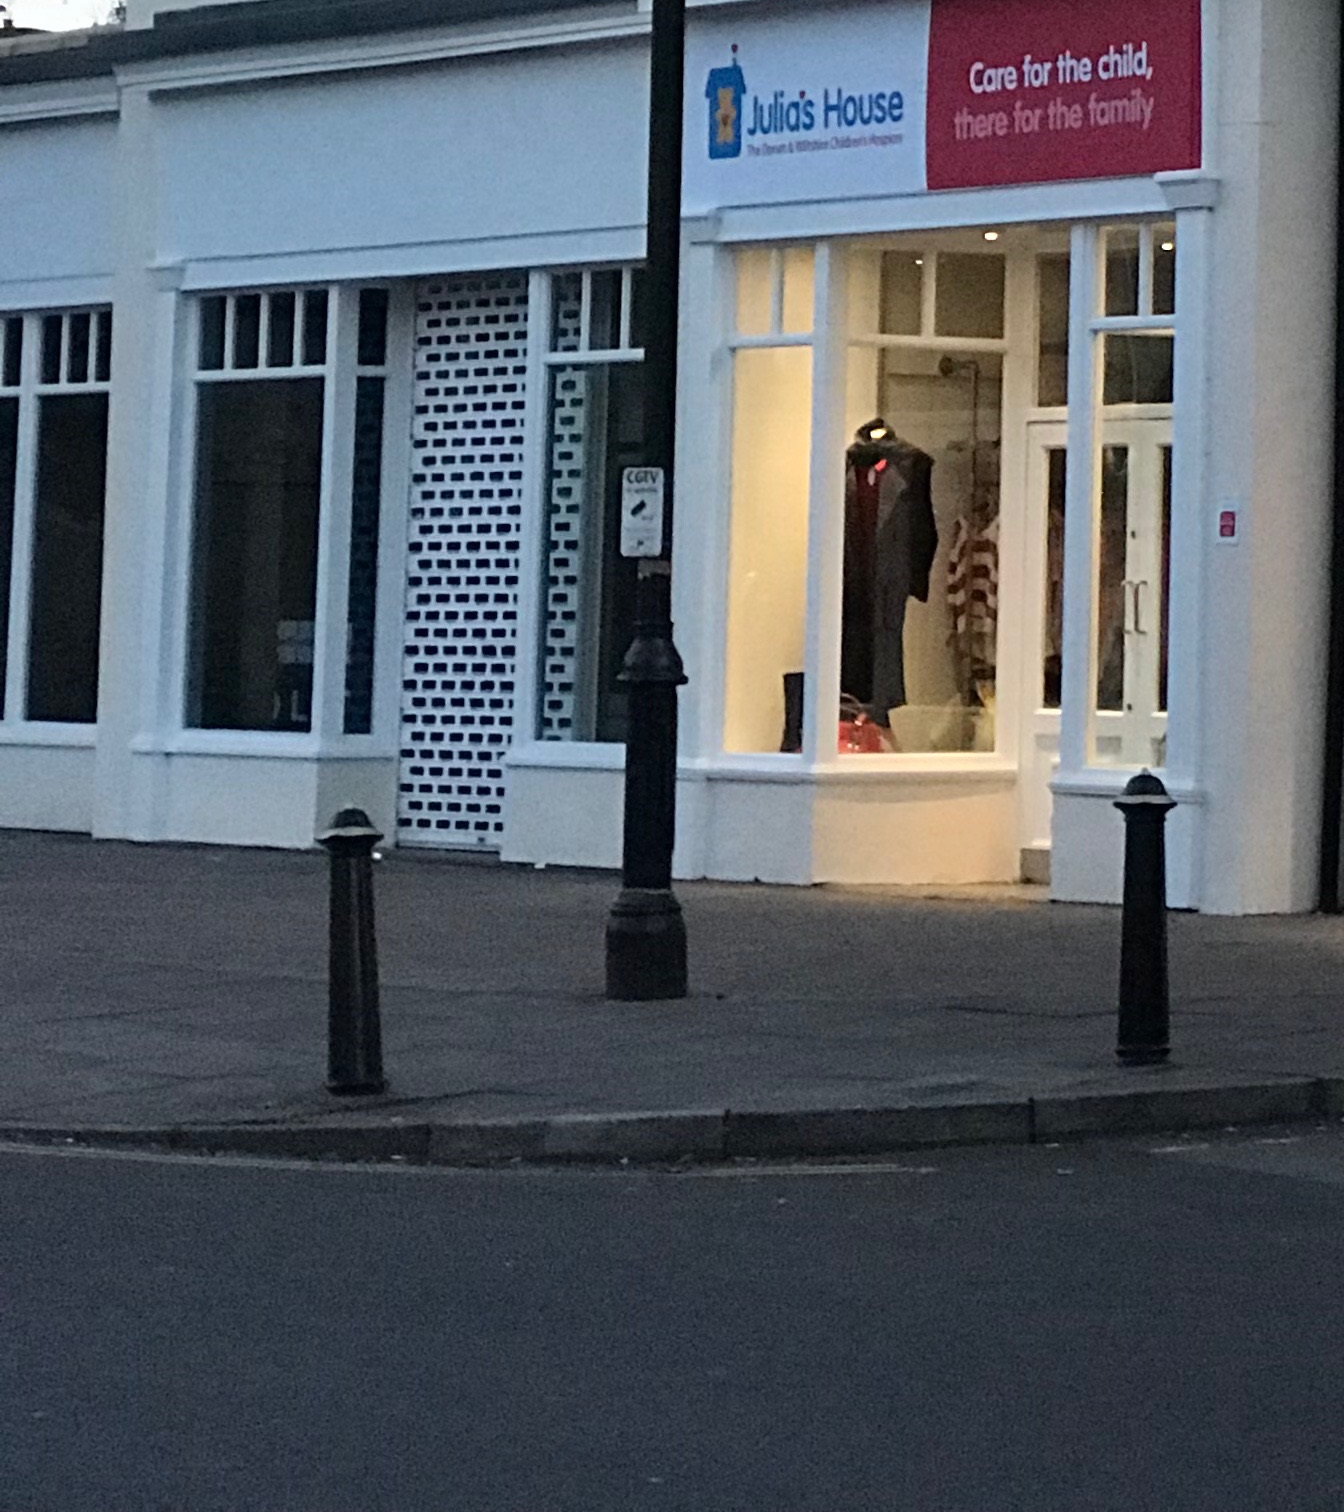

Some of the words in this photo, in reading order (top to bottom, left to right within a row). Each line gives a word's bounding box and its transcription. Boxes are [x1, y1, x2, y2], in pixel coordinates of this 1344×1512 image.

[969, 62, 1017, 94] Care
[1022, 54, 1052, 87] for
[1056, 50, 1092, 83] the
[1098, 41, 1153, 80] child,
[747, 90, 815, 136] Julia's
[824, 87, 904, 129] House
[954, 107, 1008, 139] there
[1013, 100, 1043, 134] for
[1047, 96, 1083, 131] the
[1088, 88, 1154, 130] family
